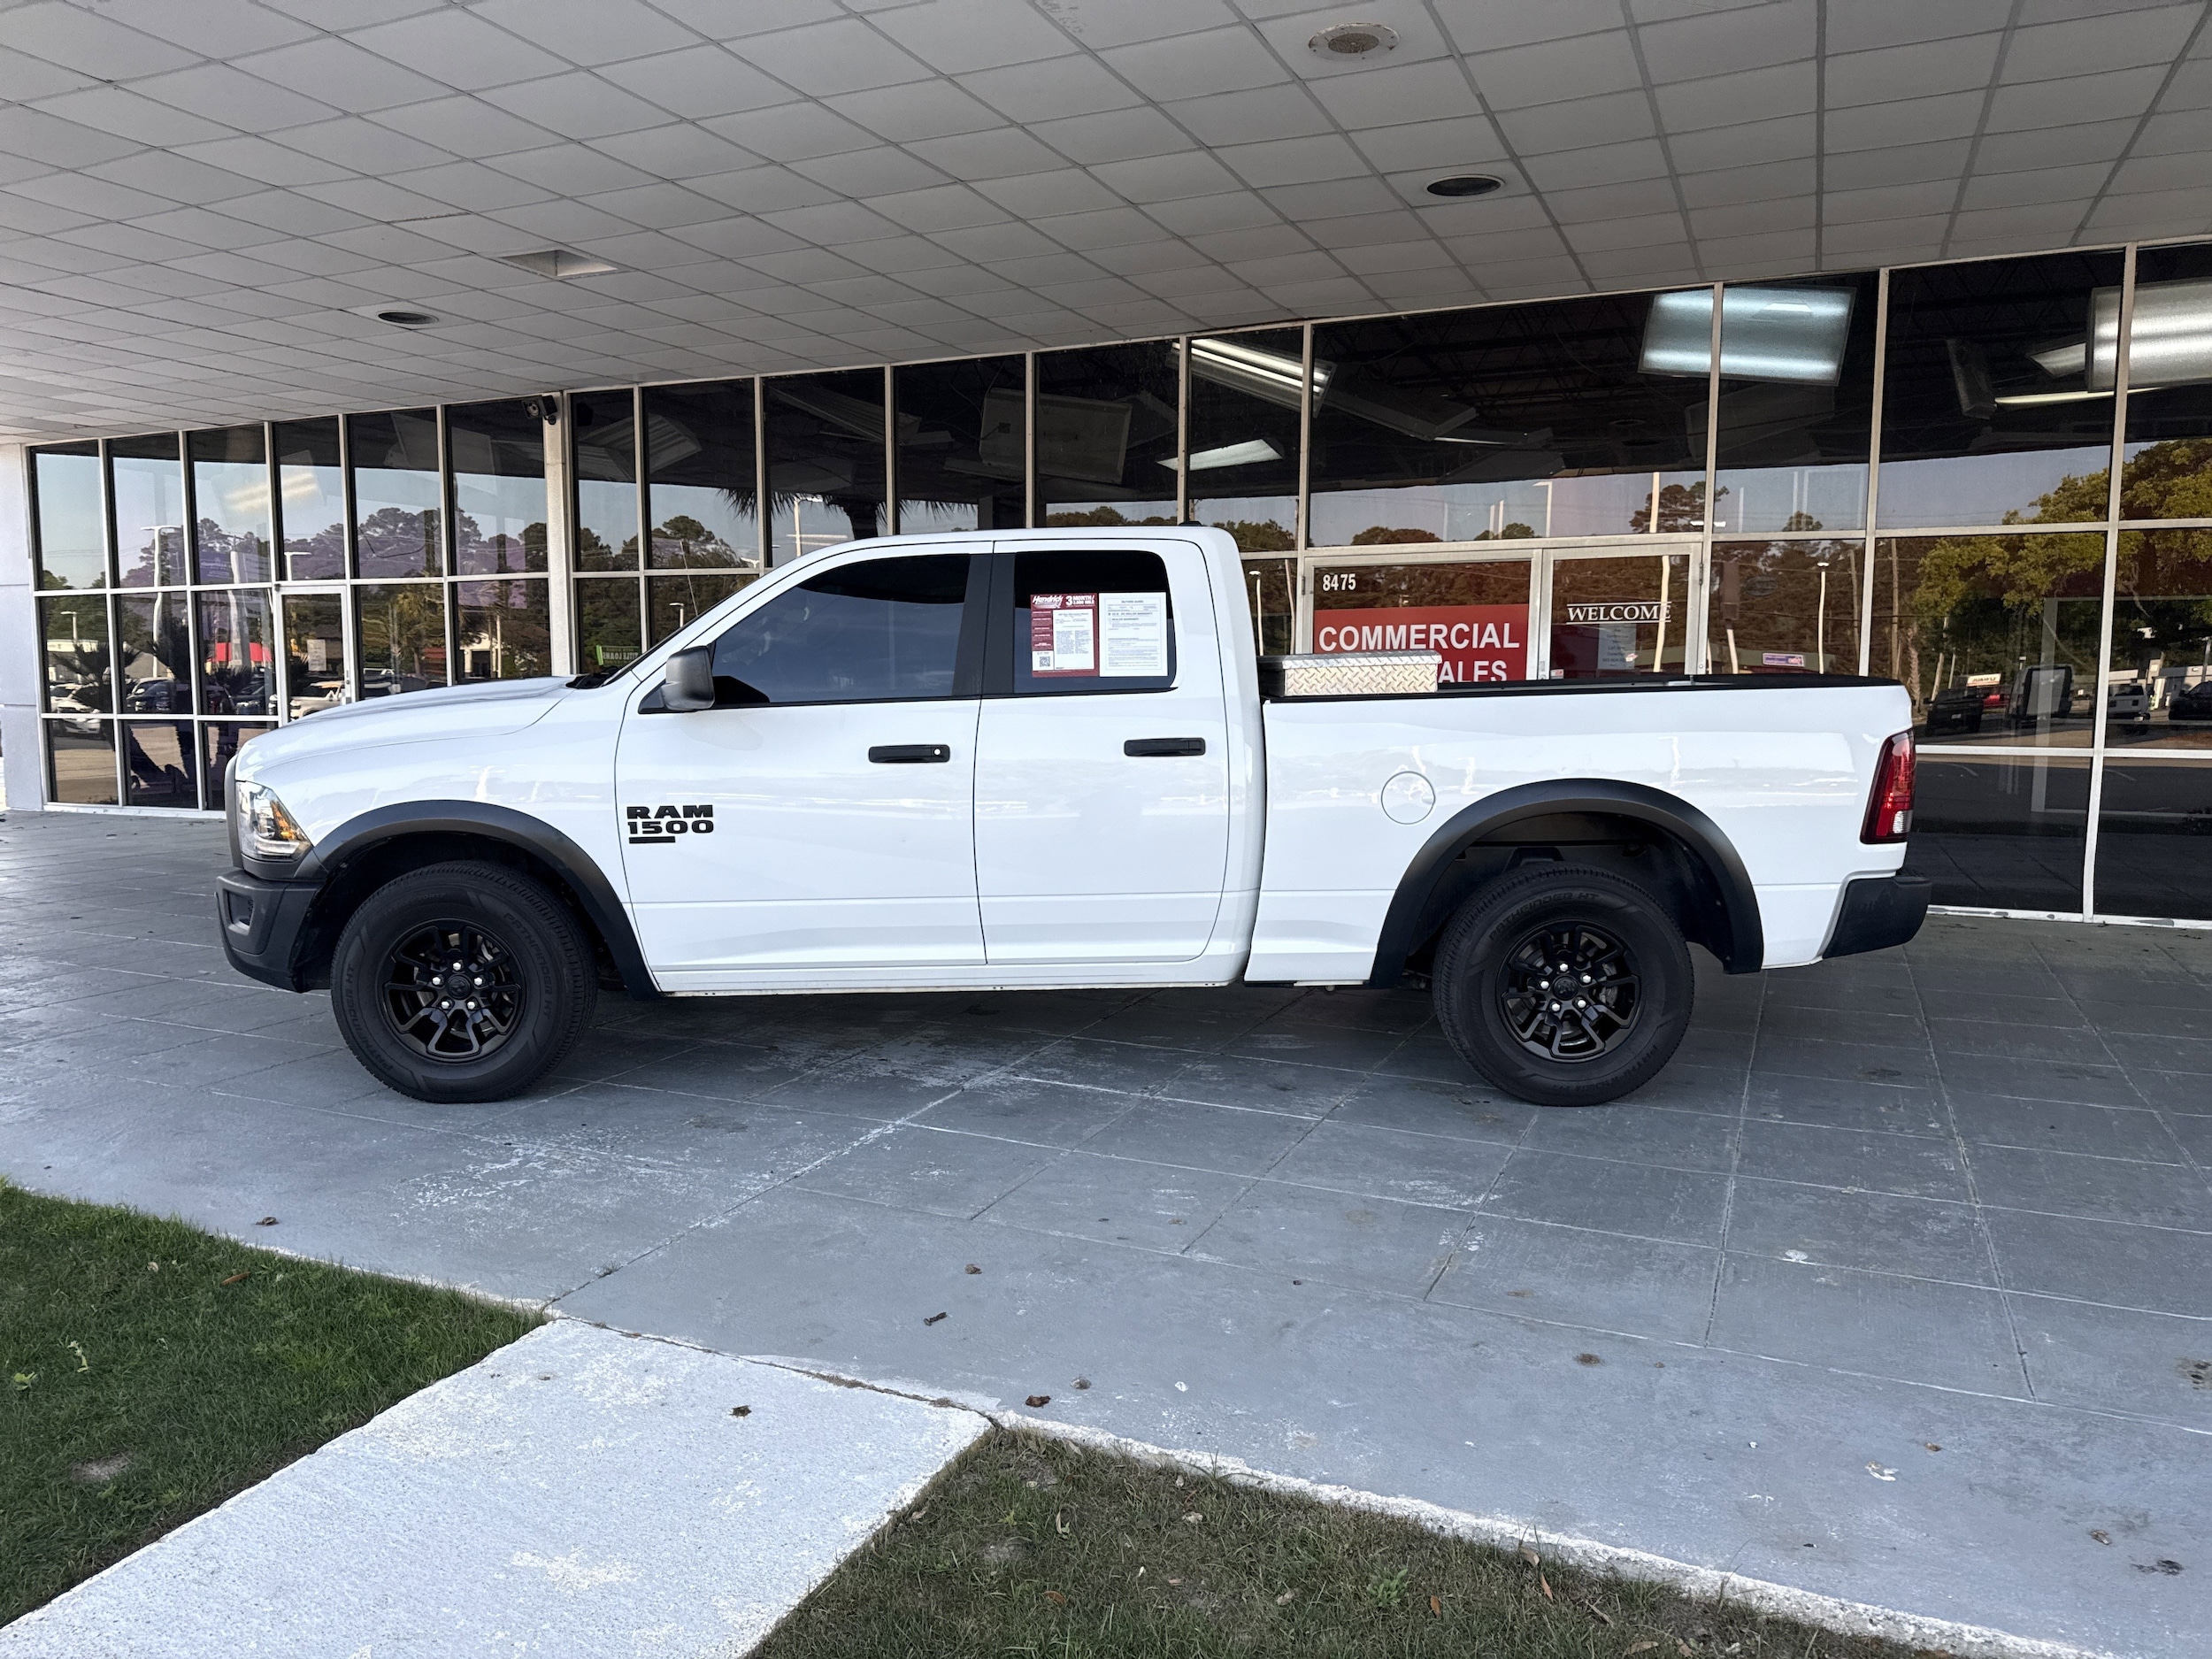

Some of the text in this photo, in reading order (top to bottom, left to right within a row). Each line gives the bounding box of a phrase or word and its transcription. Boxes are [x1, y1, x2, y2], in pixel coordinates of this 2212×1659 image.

[1322, 573, 1356, 591] 8475
[1065, 595, 1073, 606] 3
[1568, 604, 1671, 621] WELCOME
[1318, 622, 1520, 652] COMMERCIAL
[1438, 660, 1508, 683] ALES
[626, 804, 714, 819] RAM
[627, 819, 714, 834] 1500
